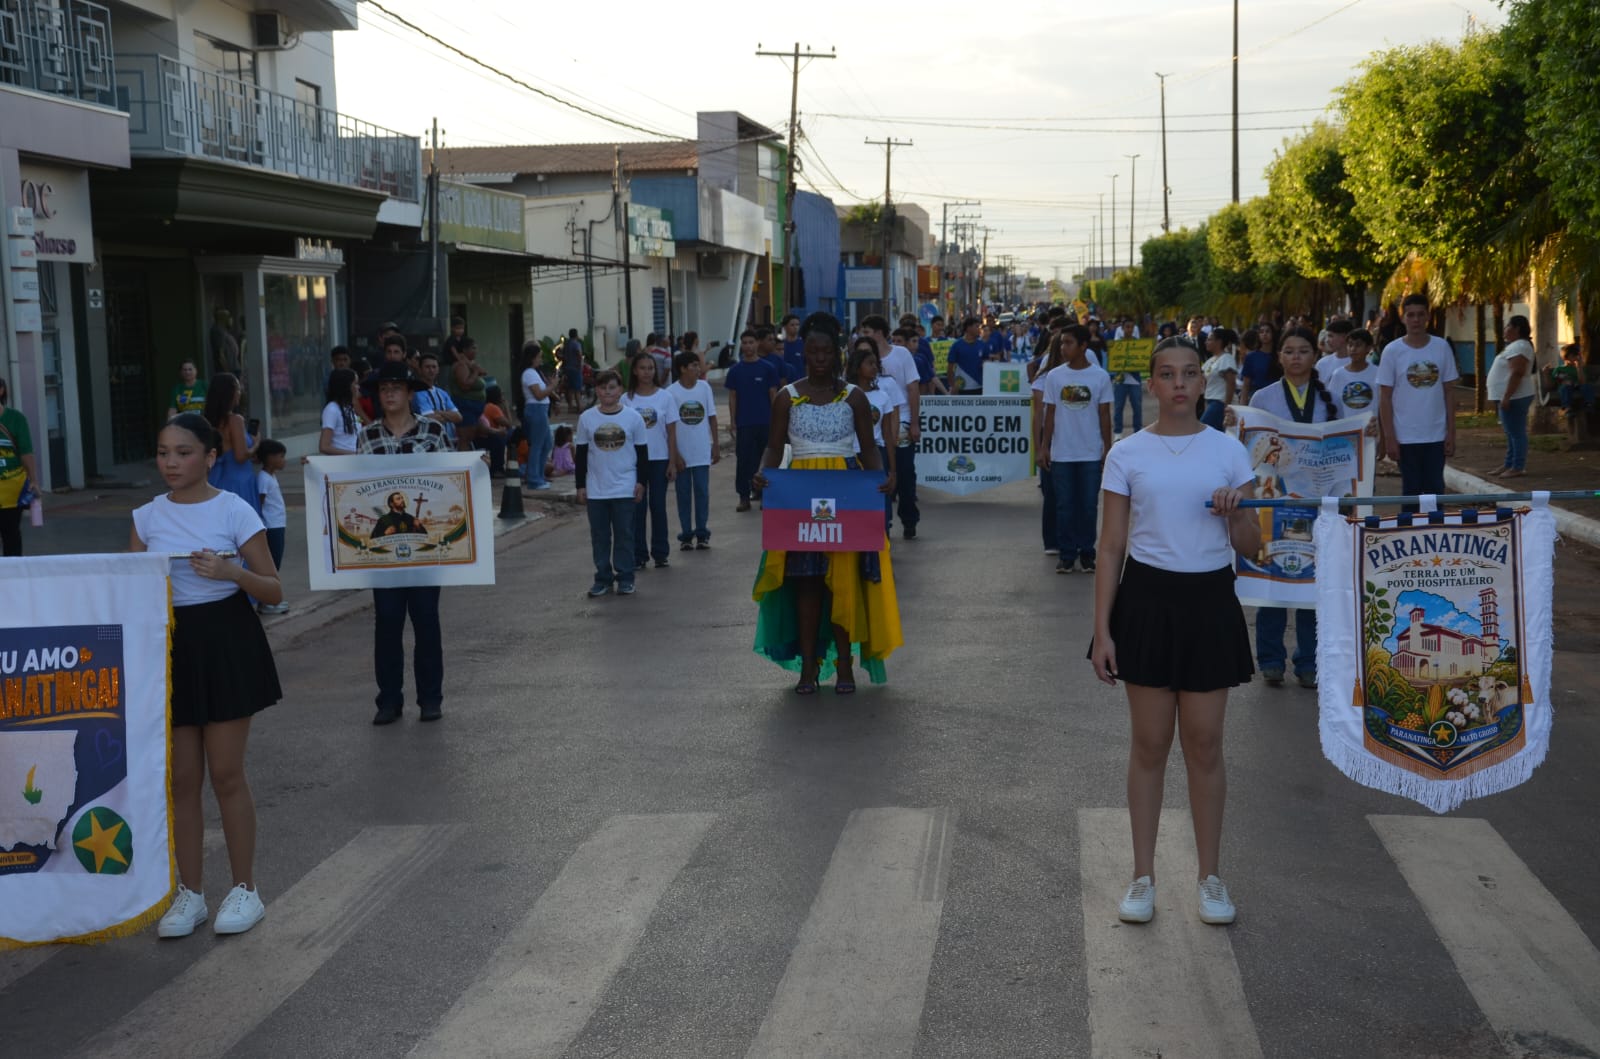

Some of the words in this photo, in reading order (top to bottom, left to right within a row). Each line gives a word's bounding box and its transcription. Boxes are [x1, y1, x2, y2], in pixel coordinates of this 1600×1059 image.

[918, 411, 987, 433] ÉCNICO
[993, 415, 1021, 433] EM
[914, 433, 1029, 455] GRONEGÓCIO
[356, 485, 371, 496] SÃO
[372, 478, 415, 489] FRANCISCO
[417, 478, 444, 491] XAVIER
[924, 474, 956, 483] EDUCAÇÃO
[981, 475, 1002, 483] CAMPO
[798, 522, 843, 544] HAITI
[1367, 532, 1508, 569] PARANATINGA
[1387, 578, 1415, 589] POVO
[1417, 576, 1494, 588] HOSPITALEIRO
[1403, 570, 1441, 579] TERRA
[1442, 568, 1458, 578] DE
[1459, 567, 1476, 577] UM
[0, 650, 18, 675] U
[22, 645, 79, 673] AMO
[0, 667, 119, 720] NATINGA!
[1390, 728, 1437, 745] PARANATINGA
[1461, 733, 1478, 743] MATO
[1478, 727, 1498, 737] GROSSO
